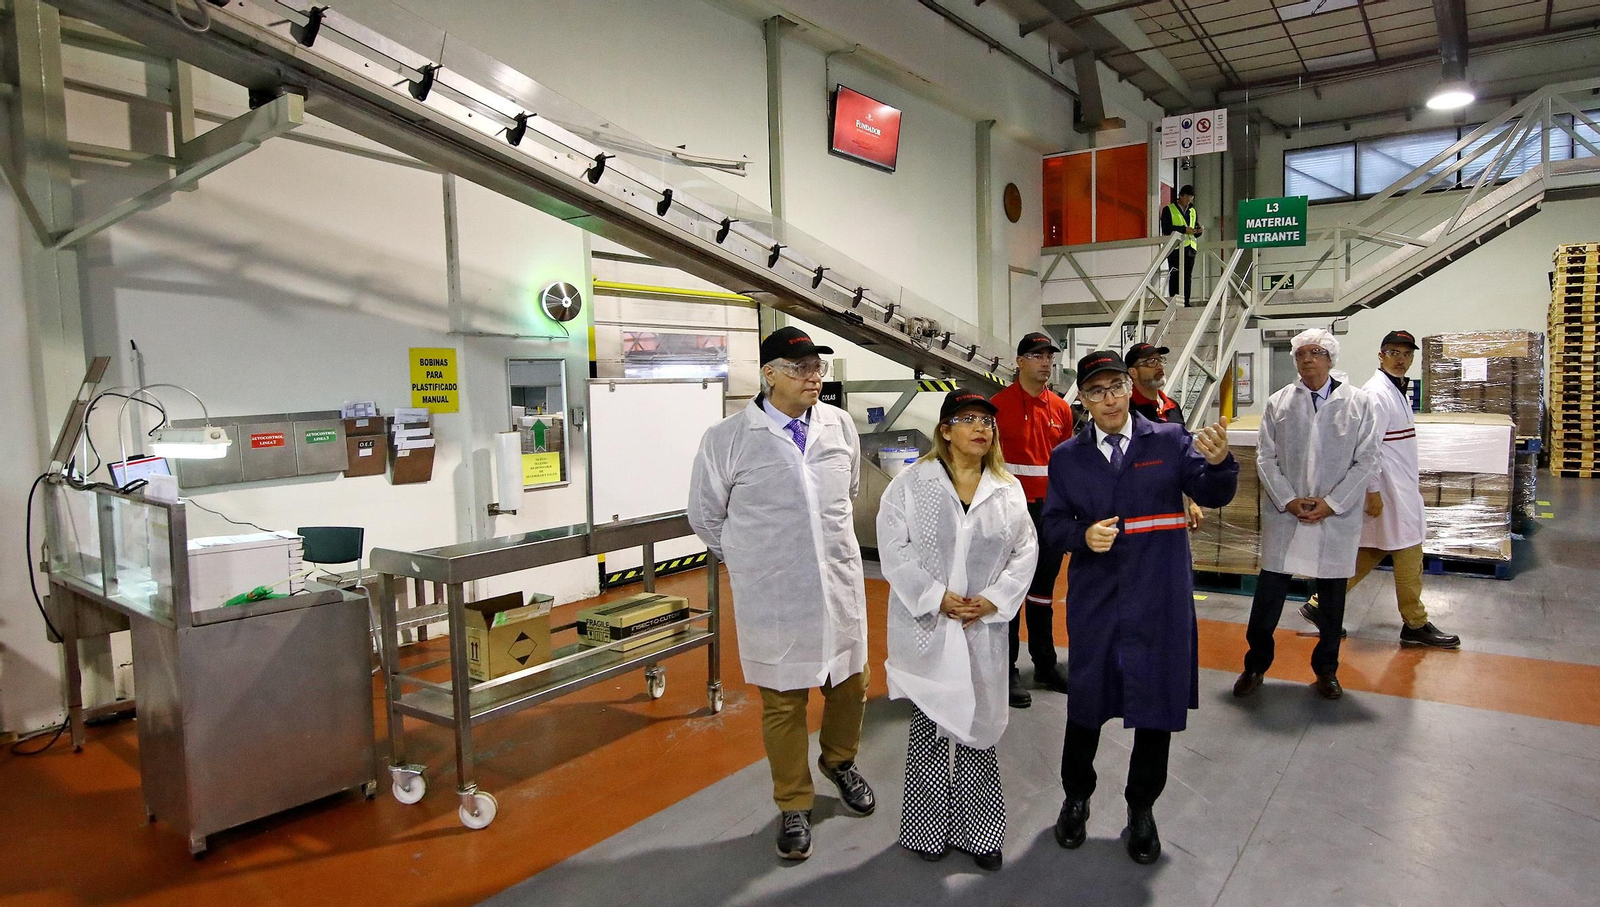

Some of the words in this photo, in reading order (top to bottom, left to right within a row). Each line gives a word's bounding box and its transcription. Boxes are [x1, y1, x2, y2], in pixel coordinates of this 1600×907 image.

[856, 119, 881, 136] FUNDADOR
[1266, 202, 1280, 213] L3
[1246, 216, 1299, 228] MATERIAL
[1243, 231, 1300, 243] ENTRANTE
[419, 358, 449, 367] BOBINAS
[426, 370, 443, 378] PARA
[412, 383, 457, 391] PLASTIFICADO
[422, 395, 449, 403] MANUAL
[586, 619, 610, 628] FRAGILE
